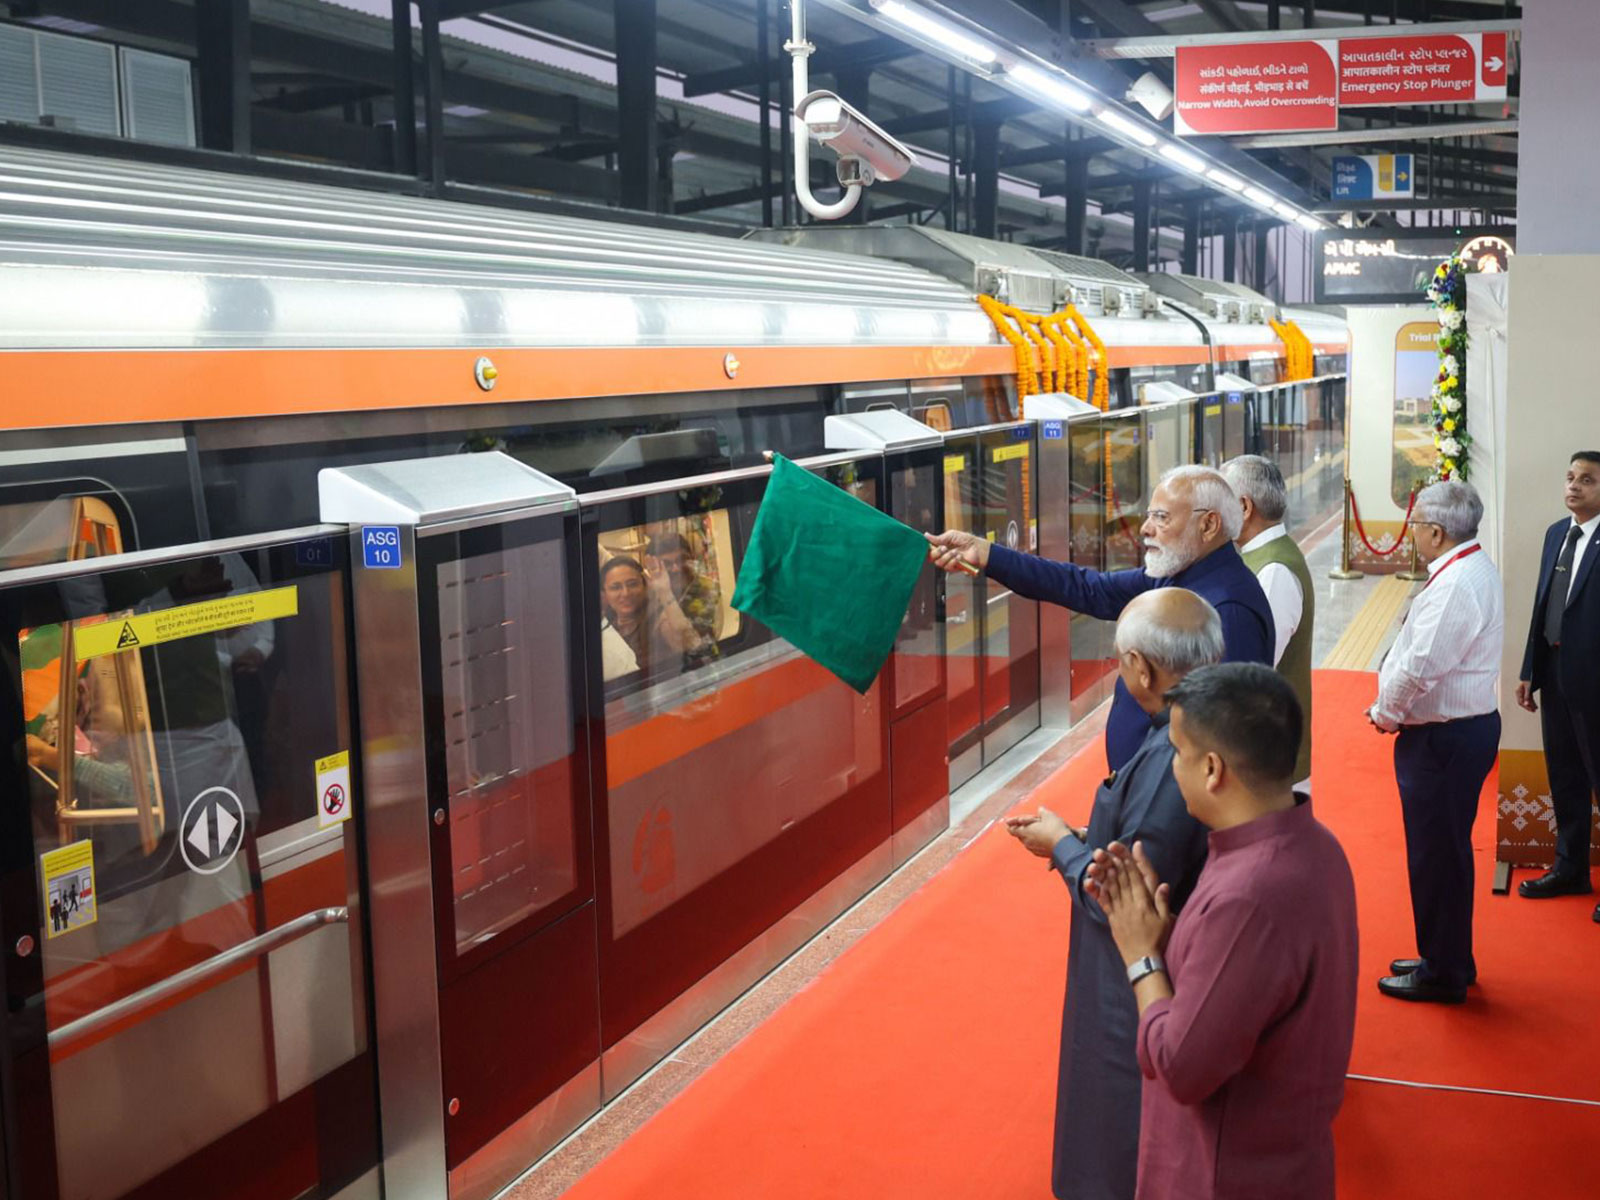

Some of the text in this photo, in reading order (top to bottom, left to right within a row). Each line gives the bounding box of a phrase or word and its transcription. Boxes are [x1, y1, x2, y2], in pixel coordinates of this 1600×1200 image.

[1342, 78, 1473, 94] Emergency Stop Plunger
[1178, 95, 1335, 110] Narrow Width, Avoid Overcrowding
[1323, 261, 1361, 276] APMC
[1409, 333, 1432, 342] Trial
[366, 531, 397, 546] ASG
[374, 549, 391, 564] 10
